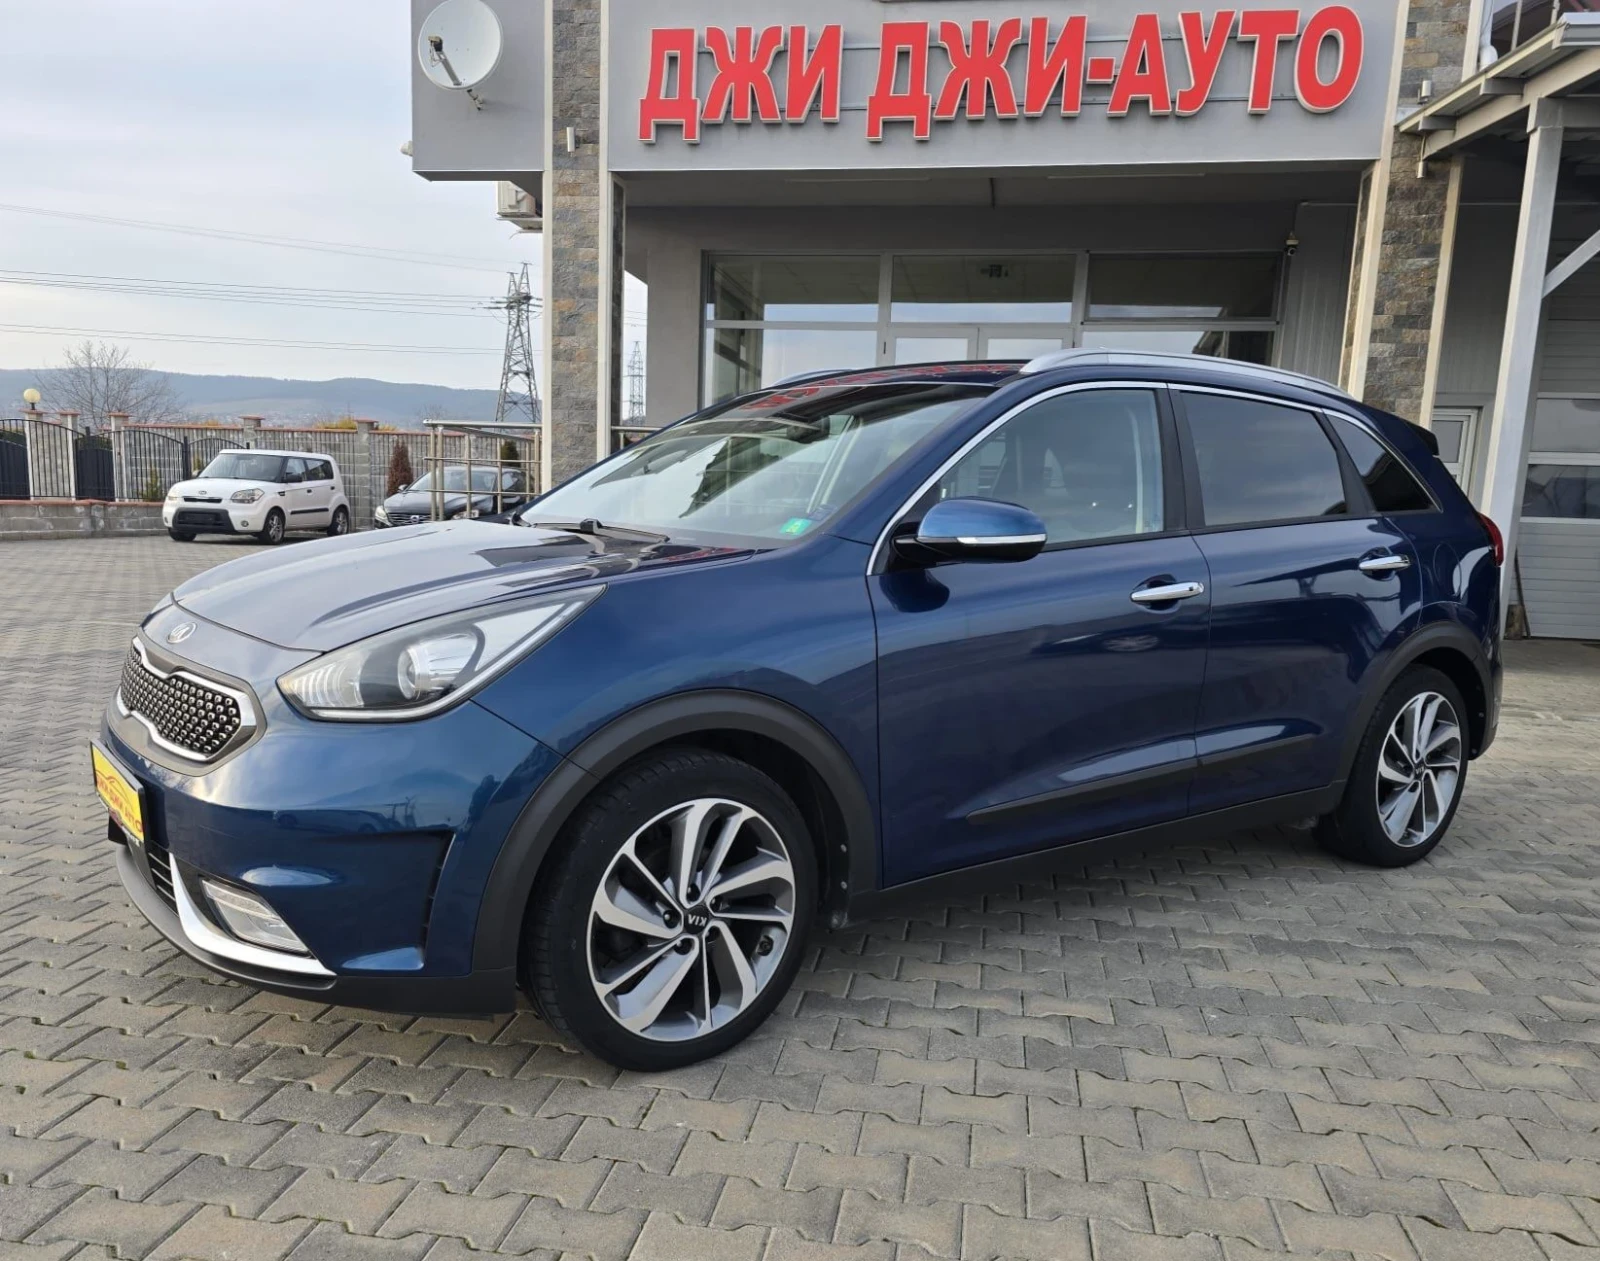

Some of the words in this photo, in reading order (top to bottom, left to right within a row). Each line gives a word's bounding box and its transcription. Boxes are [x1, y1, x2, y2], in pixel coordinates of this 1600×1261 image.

[638, 25, 843, 144] ДЖИ
[865, 5, 1364, 142] ДЖИ-АУТО
[688, 914, 708, 927] KIA
